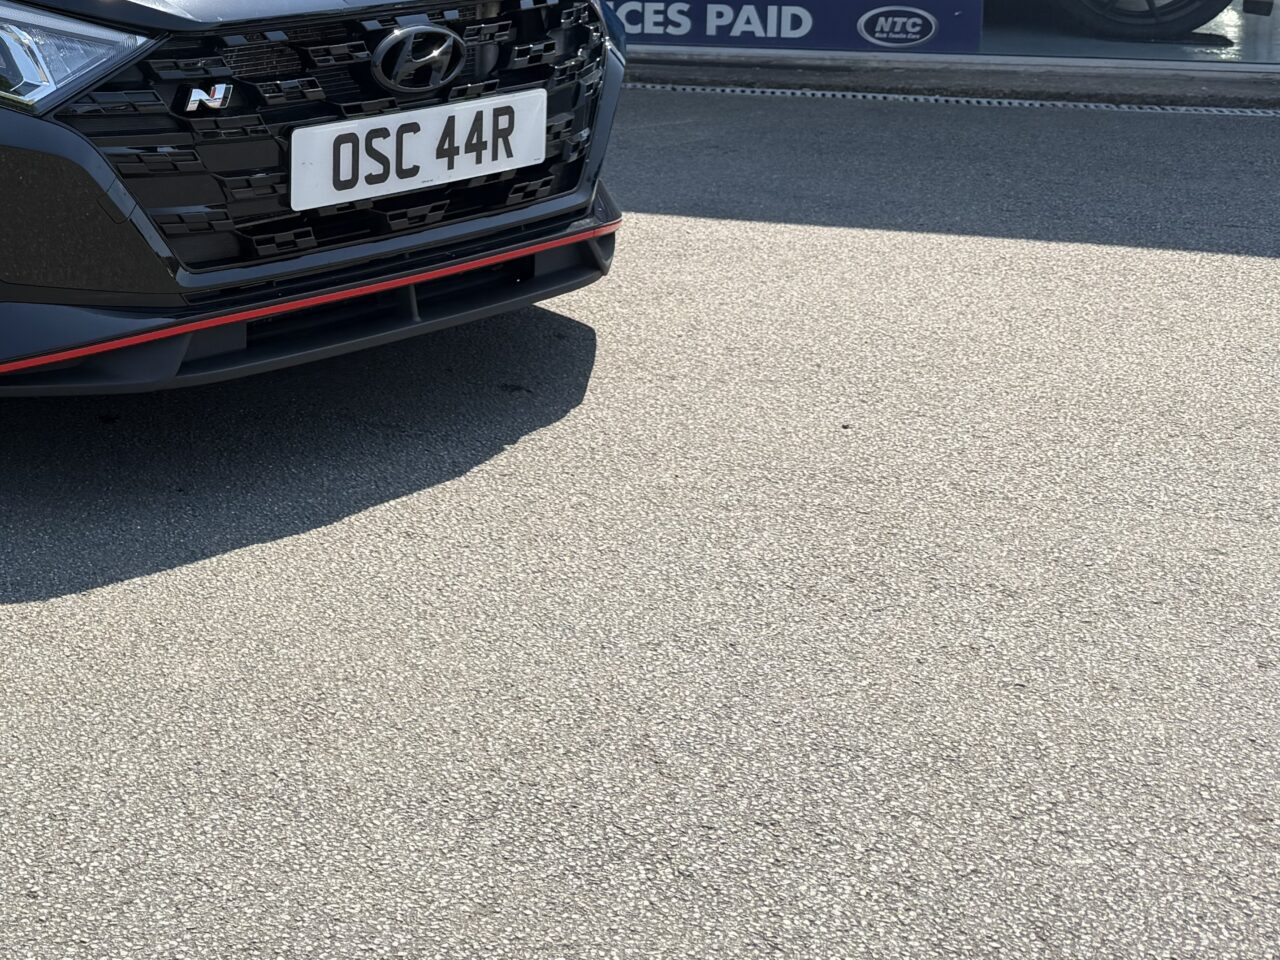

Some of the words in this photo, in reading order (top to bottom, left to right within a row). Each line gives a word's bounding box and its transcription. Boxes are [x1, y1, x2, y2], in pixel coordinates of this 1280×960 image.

[706, 3, 813, 38] PAID
[875, 16, 923, 33] NTC
[332, 121, 421, 192] OSC
[435, 105, 516, 171] 44R
